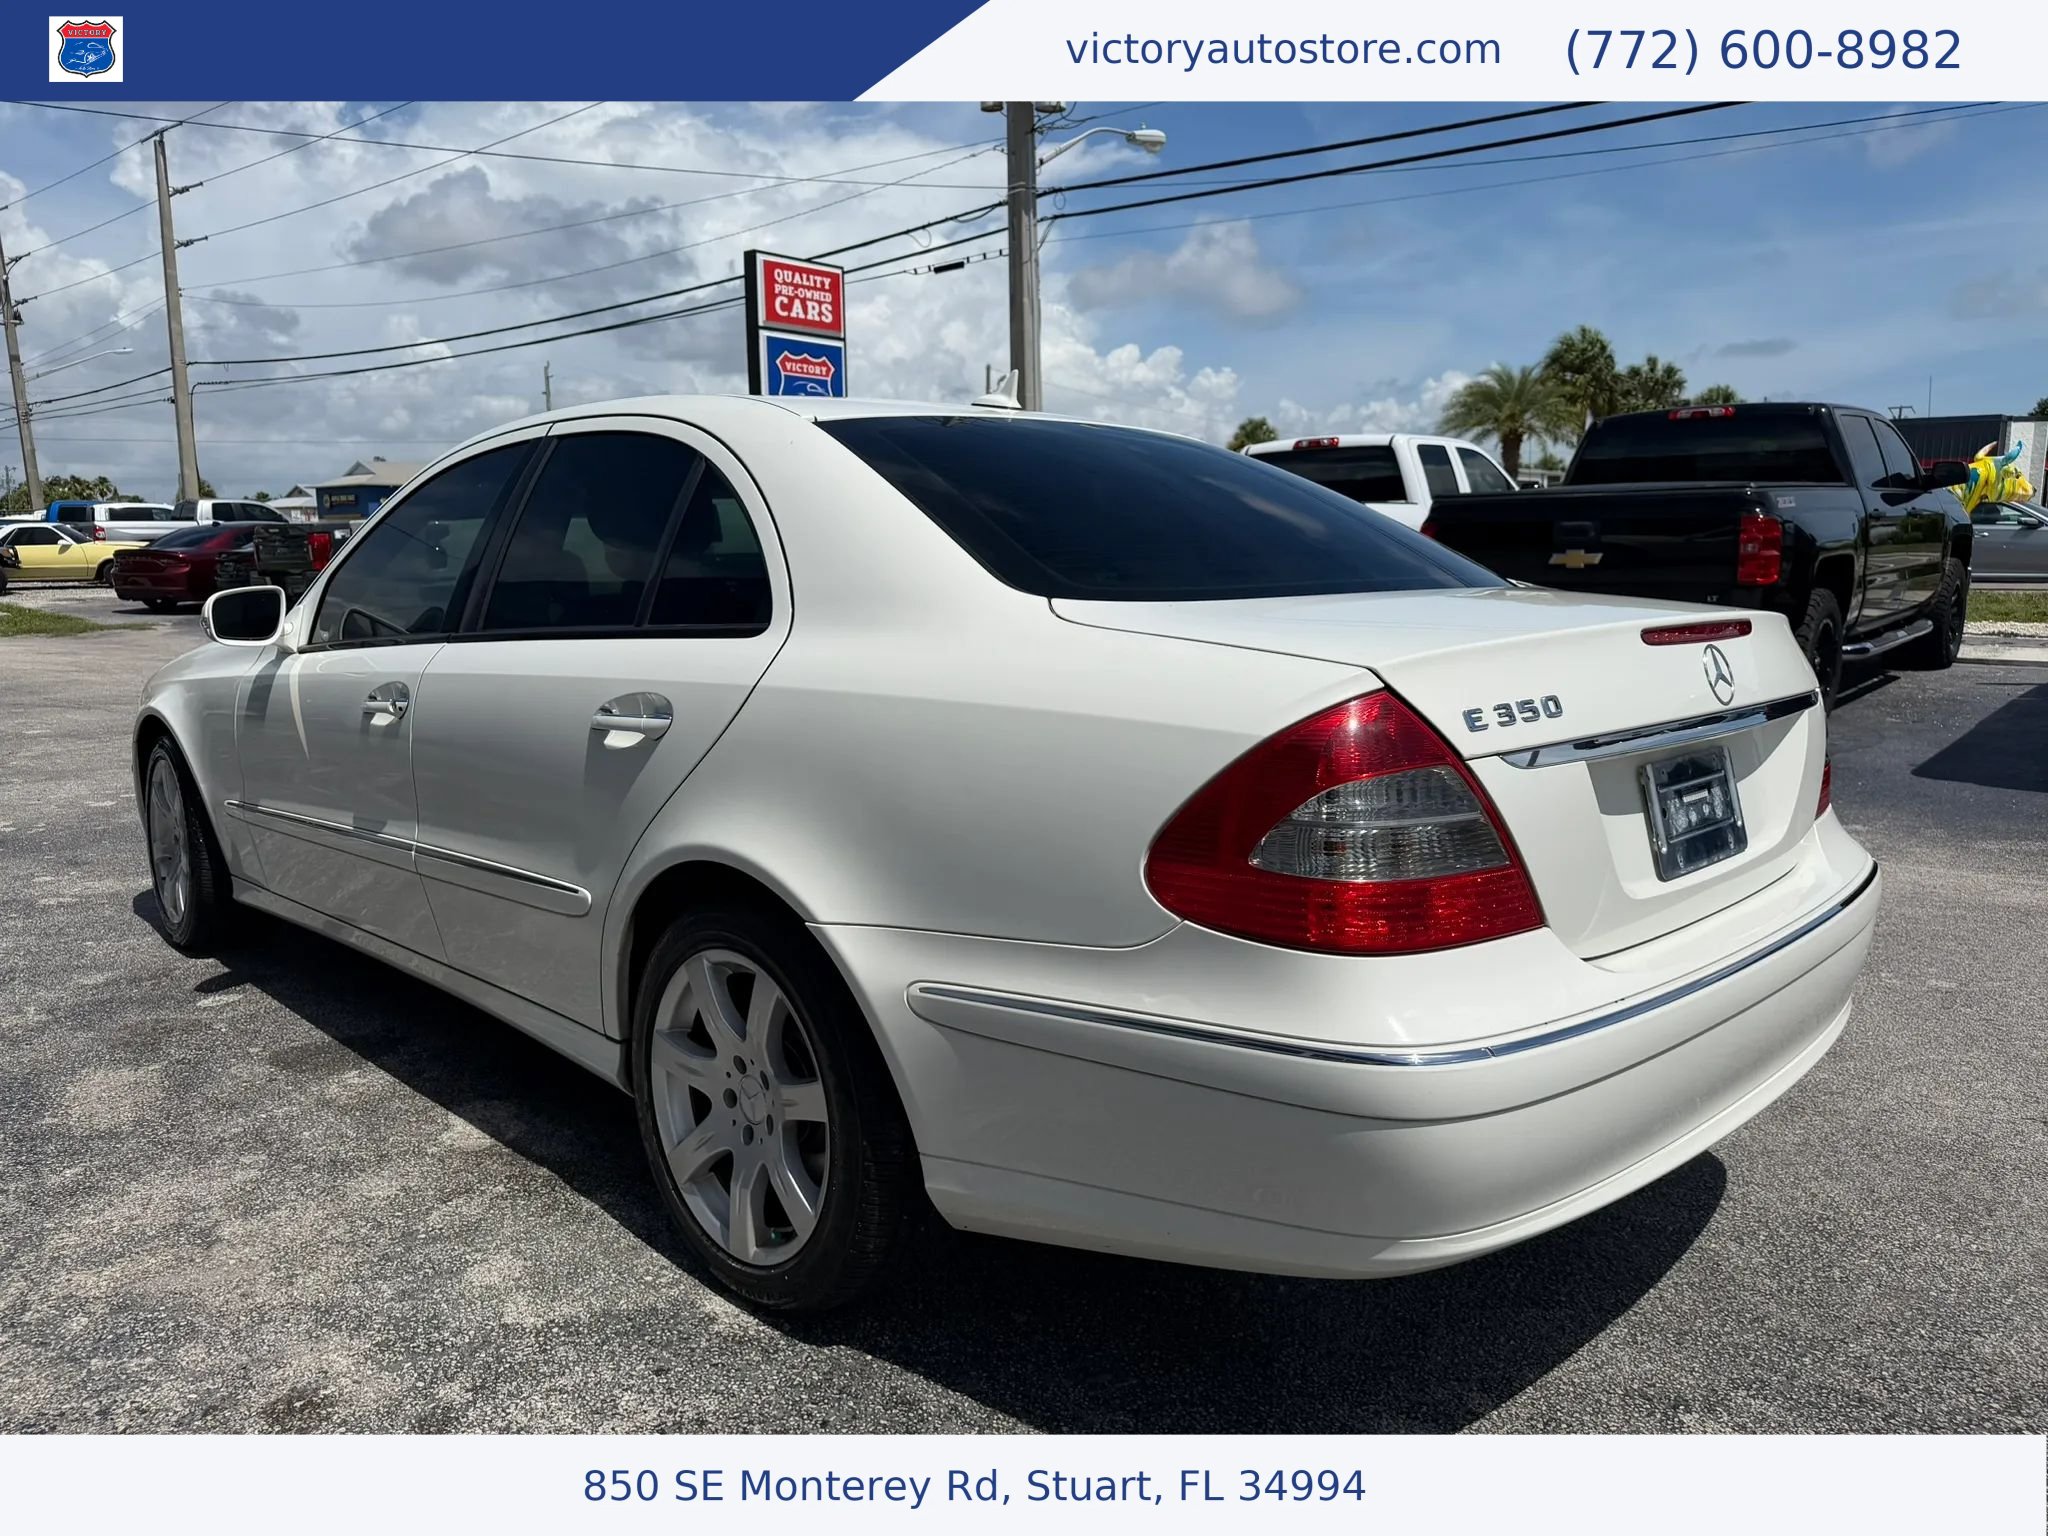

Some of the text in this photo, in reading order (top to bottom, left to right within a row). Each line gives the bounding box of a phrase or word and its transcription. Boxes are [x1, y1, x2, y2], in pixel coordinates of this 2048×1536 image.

[773, 268, 832, 290] QUALITY
[774, 283, 832, 303] PRE-OWNED
[774, 296, 833, 323] CARS
[785, 361, 828, 376] VICTORY
[1462, 694, 1563, 732] E 350
